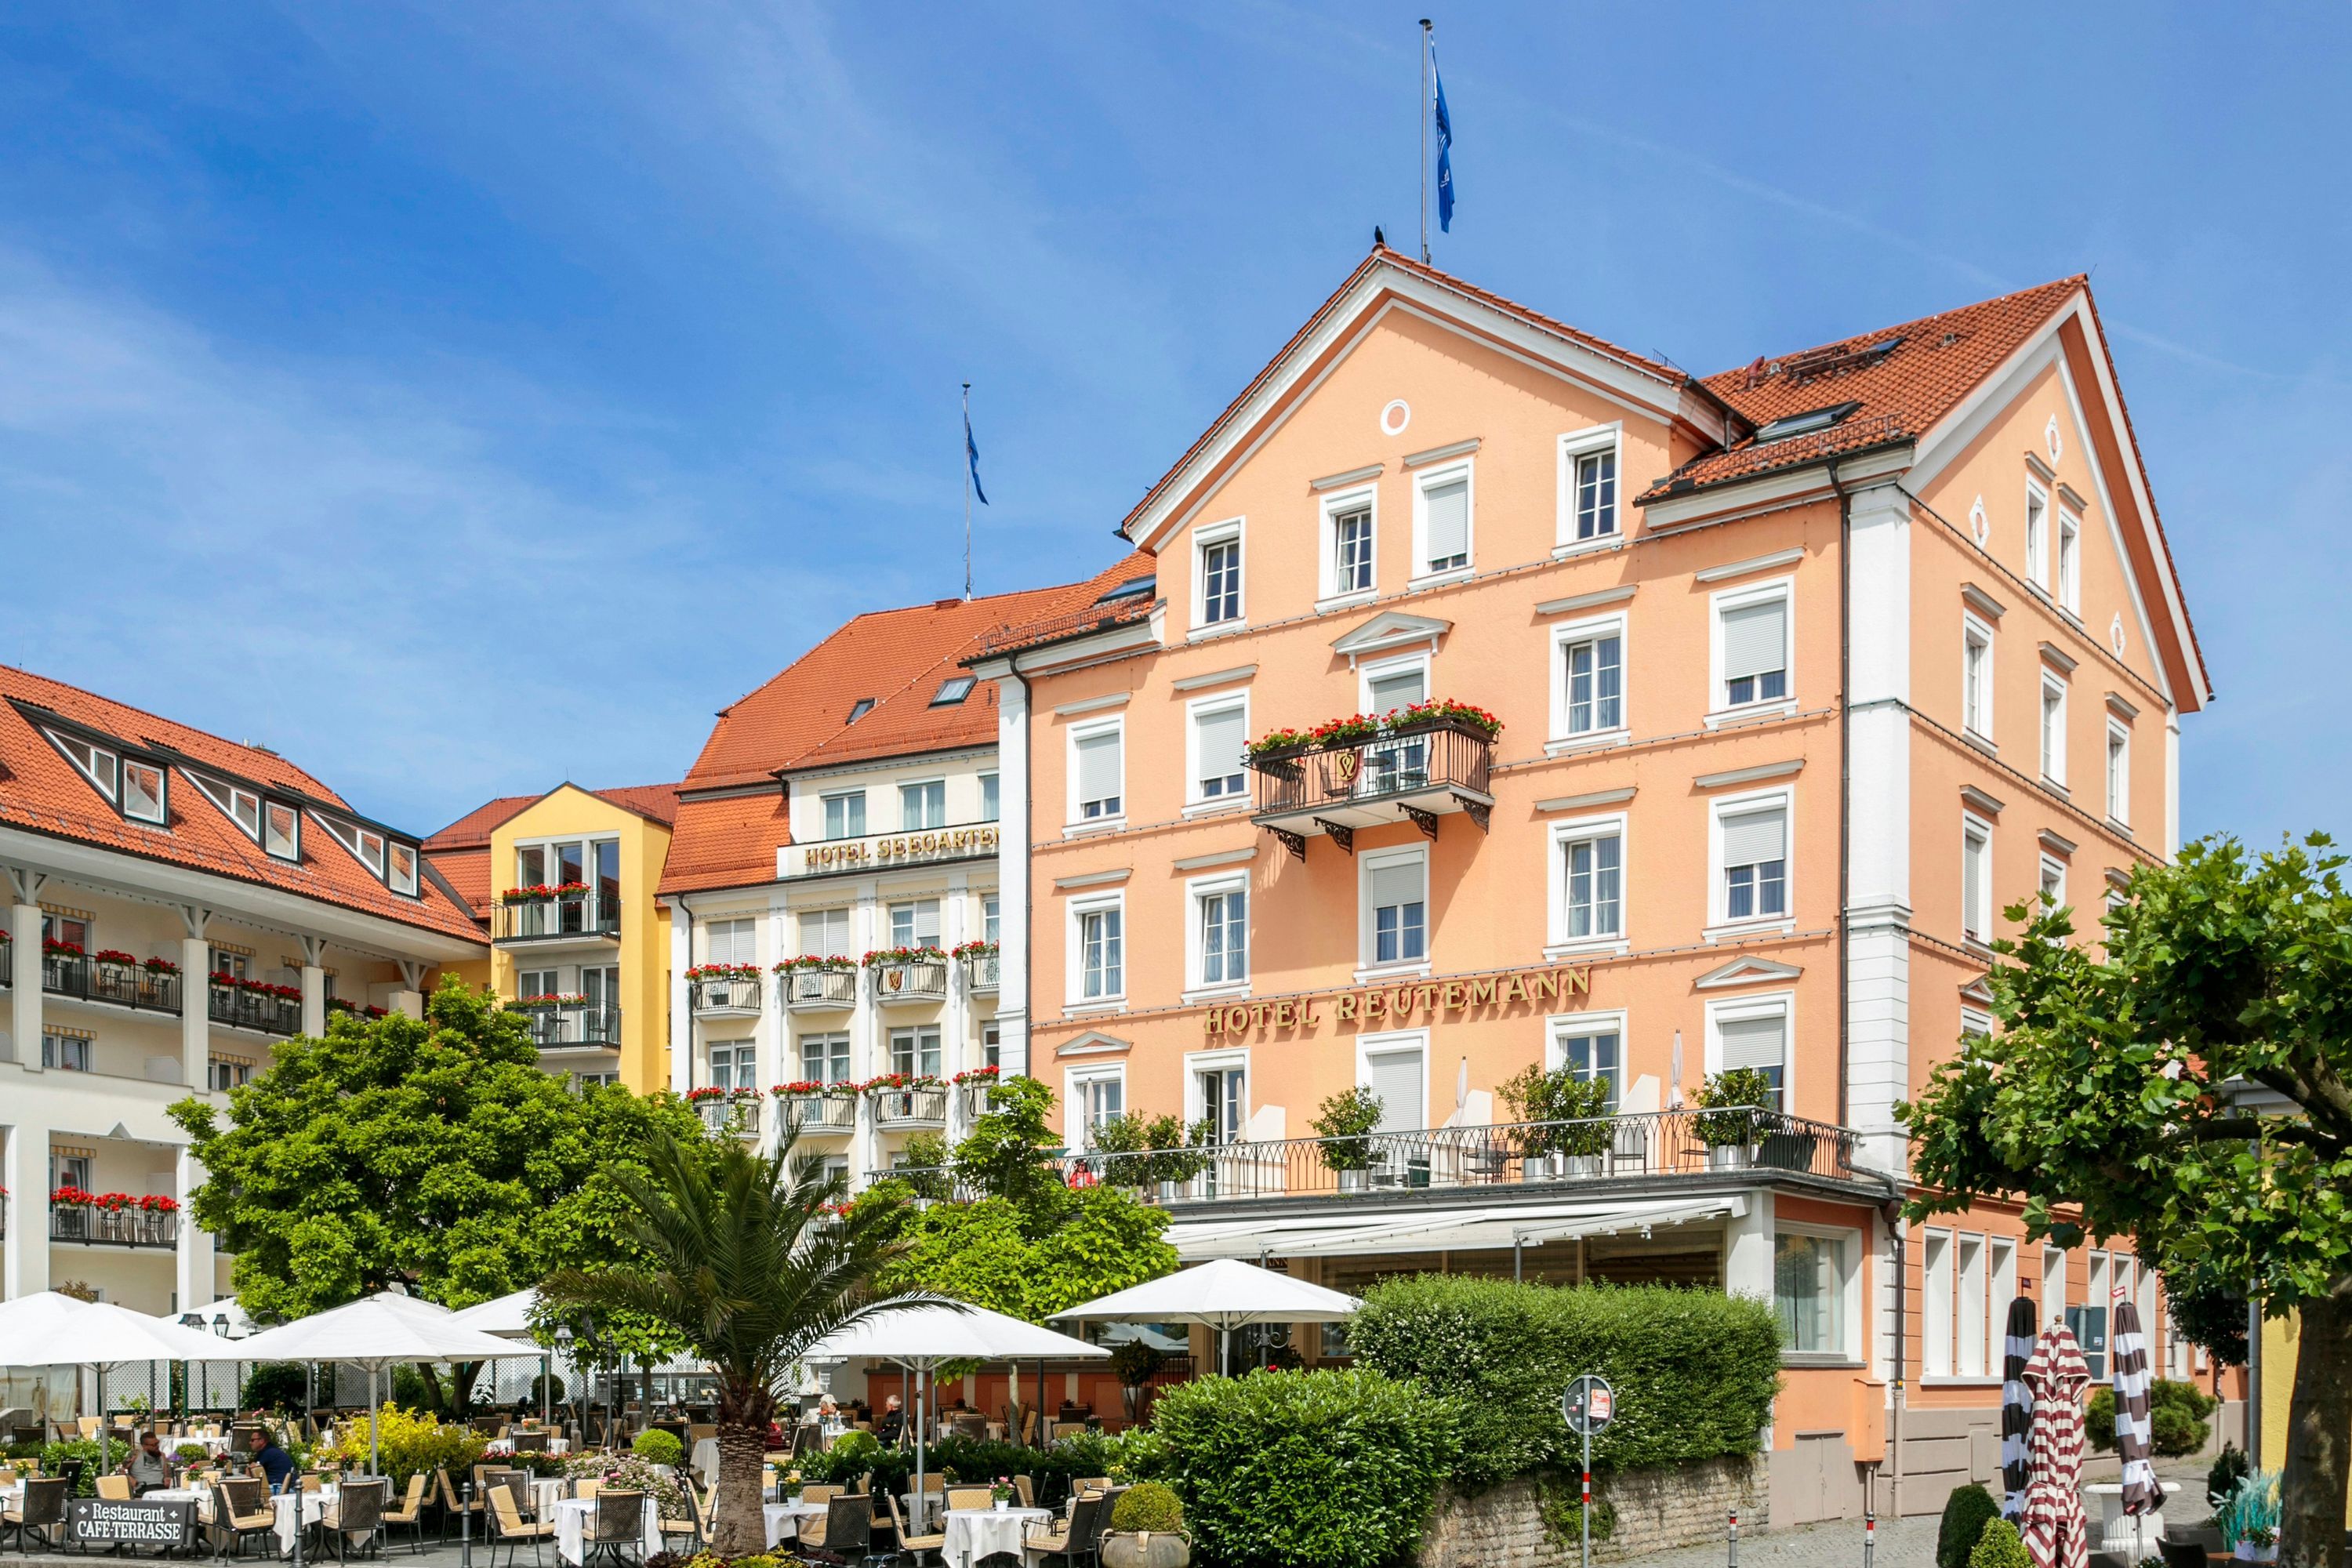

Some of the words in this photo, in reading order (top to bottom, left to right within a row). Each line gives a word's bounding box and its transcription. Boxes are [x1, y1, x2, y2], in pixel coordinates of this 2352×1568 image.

[804, 842, 870, 866] HOTEL
[1204, 998, 1319, 1035] HOTEL
[1336, 967, 1592, 1020] REUTEMANN
[92, 1503, 165, 1522] Restaurant
[78, 1519, 180, 1540] CAFÉ-TERRASSE
